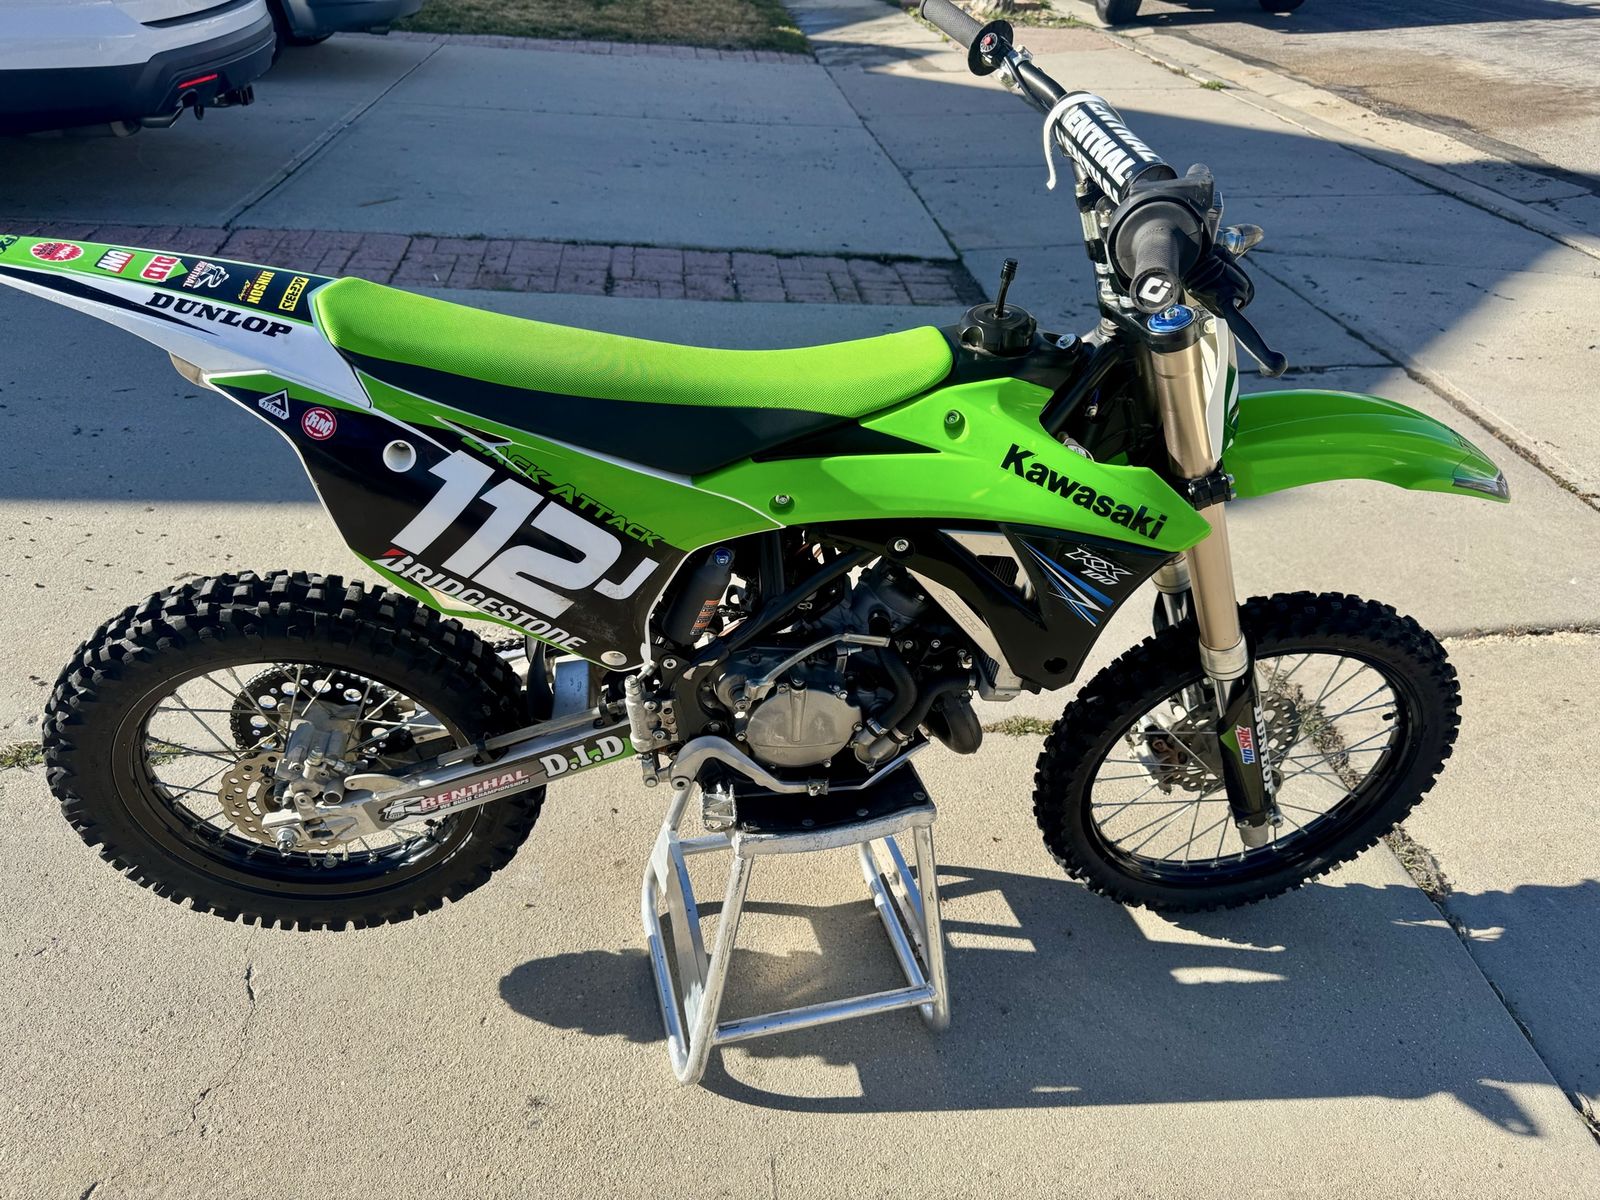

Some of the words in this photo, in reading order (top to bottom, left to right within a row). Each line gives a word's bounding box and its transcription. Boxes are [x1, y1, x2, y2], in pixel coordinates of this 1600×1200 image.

[247, 270, 275, 305] HINSON
[144, 291, 293, 338] DUNLOP
[1000, 443, 1168, 540] Kawasaki
[390, 449, 622, 619] 112
[548, 482, 666, 548] ATTACK
[1080, 569, 1119, 585] 100
[372, 550, 588, 650] BRIDGESTONE
[539, 735, 624, 777] D.I.D
[1235, 725, 1255, 764] AMSOIL
[420, 770, 529, 810] RENTHAL
